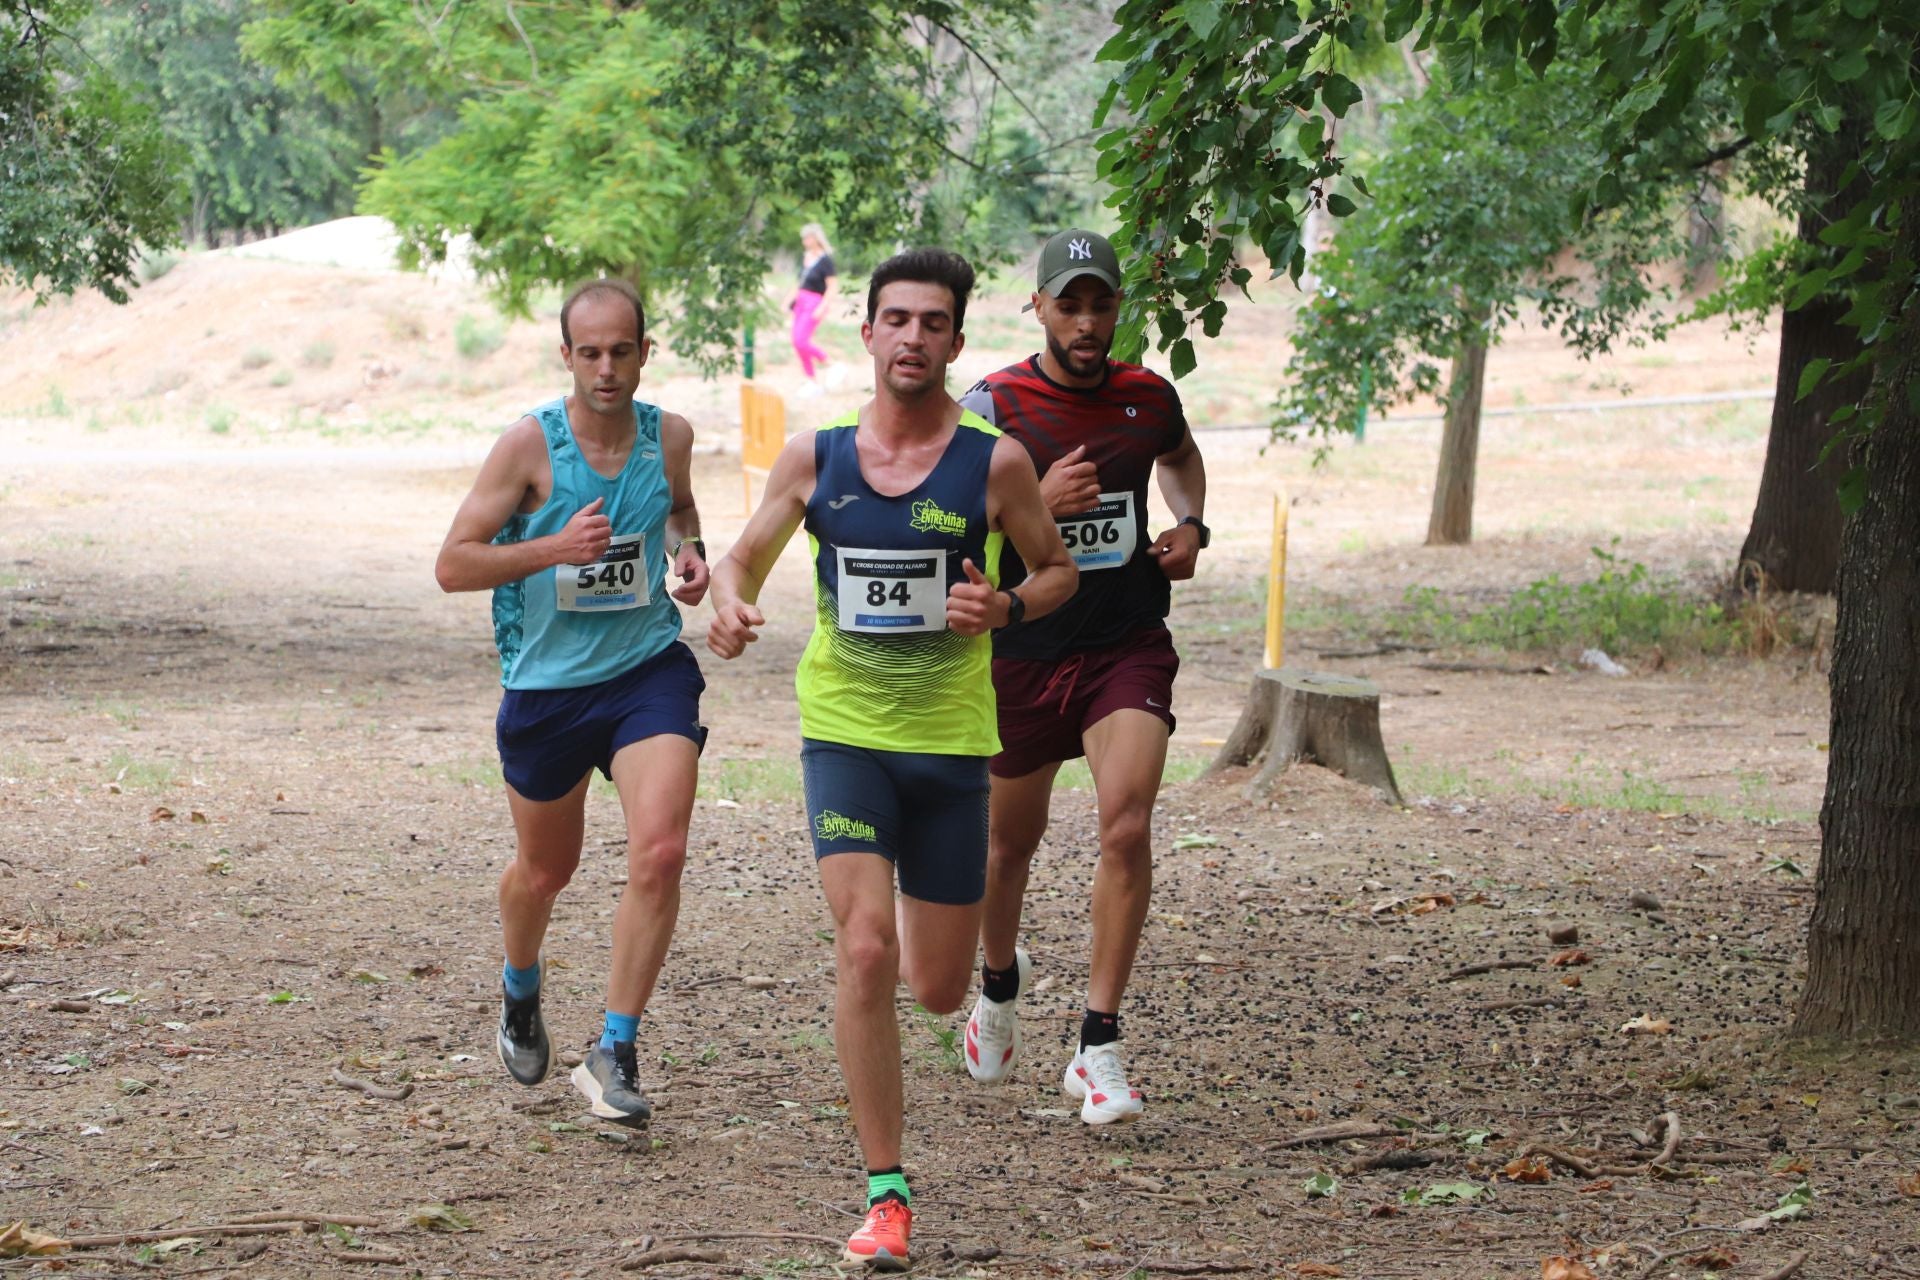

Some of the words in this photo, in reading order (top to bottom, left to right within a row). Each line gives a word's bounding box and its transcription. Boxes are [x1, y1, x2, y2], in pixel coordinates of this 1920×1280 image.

[1068, 238, 1092, 260] NY
[1060, 520, 1119, 549] 506
[577, 562, 634, 589] 540
[866, 581, 911, 606] 84
